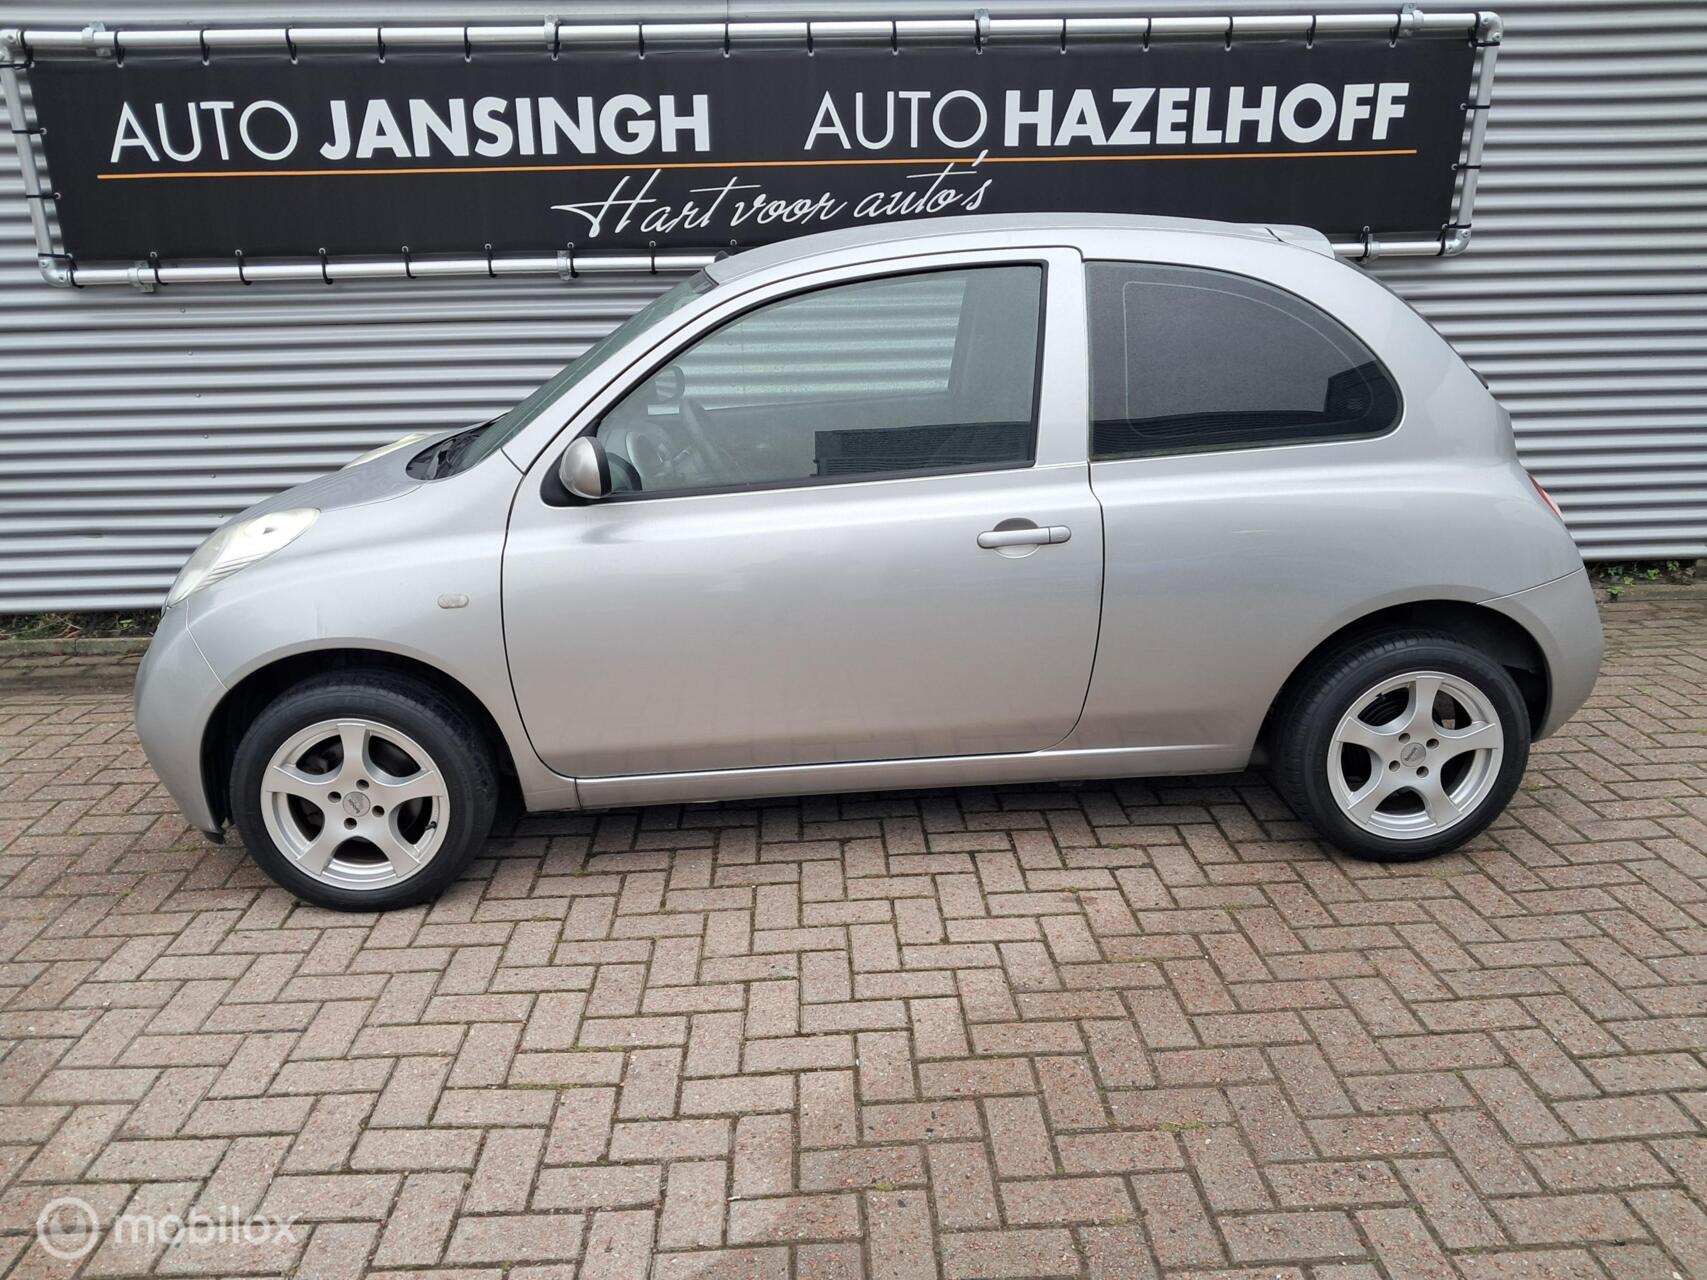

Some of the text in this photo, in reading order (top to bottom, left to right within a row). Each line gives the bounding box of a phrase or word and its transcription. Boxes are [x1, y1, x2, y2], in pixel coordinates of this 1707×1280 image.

[111, 94, 711, 163] AUTO JANSINGH
[804, 82, 1410, 151] AUTO HAZELHOFF
[551, 151, 993, 238] Hart voor auto's
